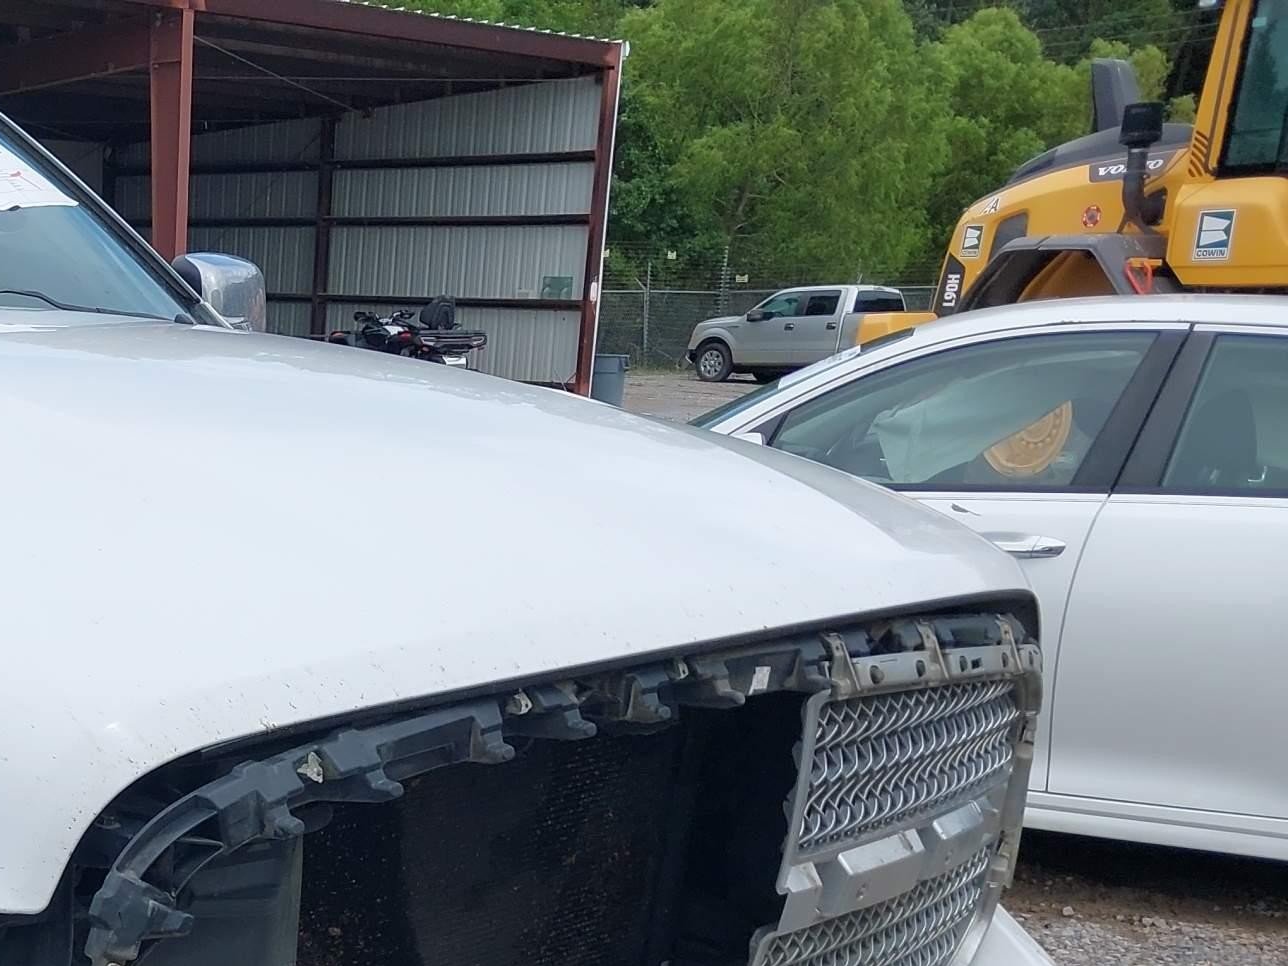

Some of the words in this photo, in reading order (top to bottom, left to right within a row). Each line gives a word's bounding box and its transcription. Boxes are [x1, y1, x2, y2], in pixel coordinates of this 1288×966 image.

[1098, 159, 1164, 176] VOO
[1196, 249, 1225, 257] COWIN
[942, 274, 961, 307] L90H
